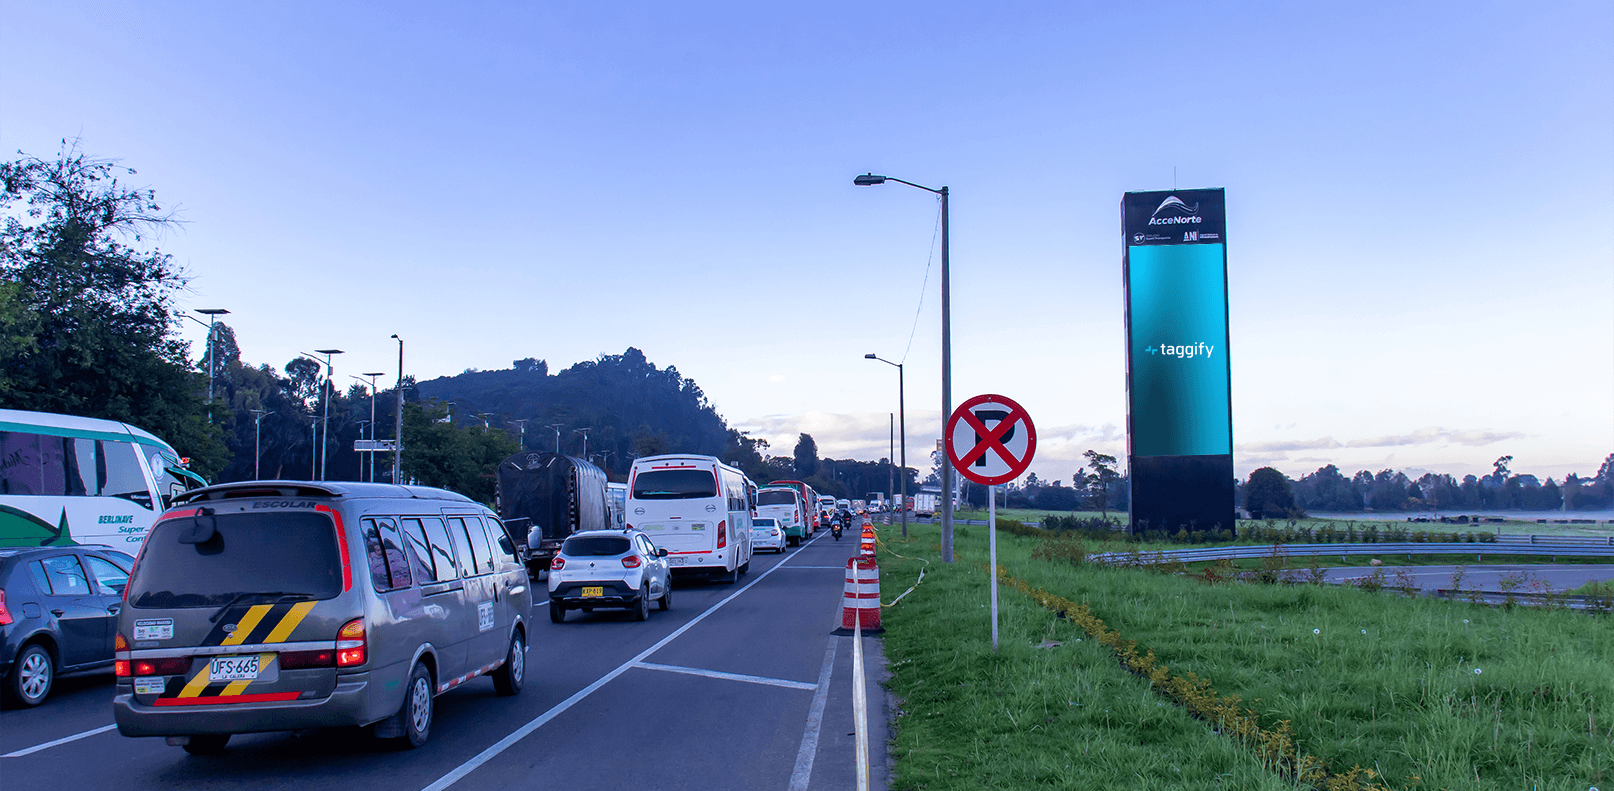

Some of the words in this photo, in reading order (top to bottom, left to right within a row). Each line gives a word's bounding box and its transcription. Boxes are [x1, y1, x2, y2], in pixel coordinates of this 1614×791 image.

[1148, 215, 1202, 226] AcceNorte
[1183, 231, 1198, 242] ANI
[1160, 342, 1214, 358] taggify
[975, 410, 1016, 467] P
[252, 500, 317, 509] ESCOLAR
[98, 515, 134, 524] BERLINAVE
[118, 526, 145, 534] Super
